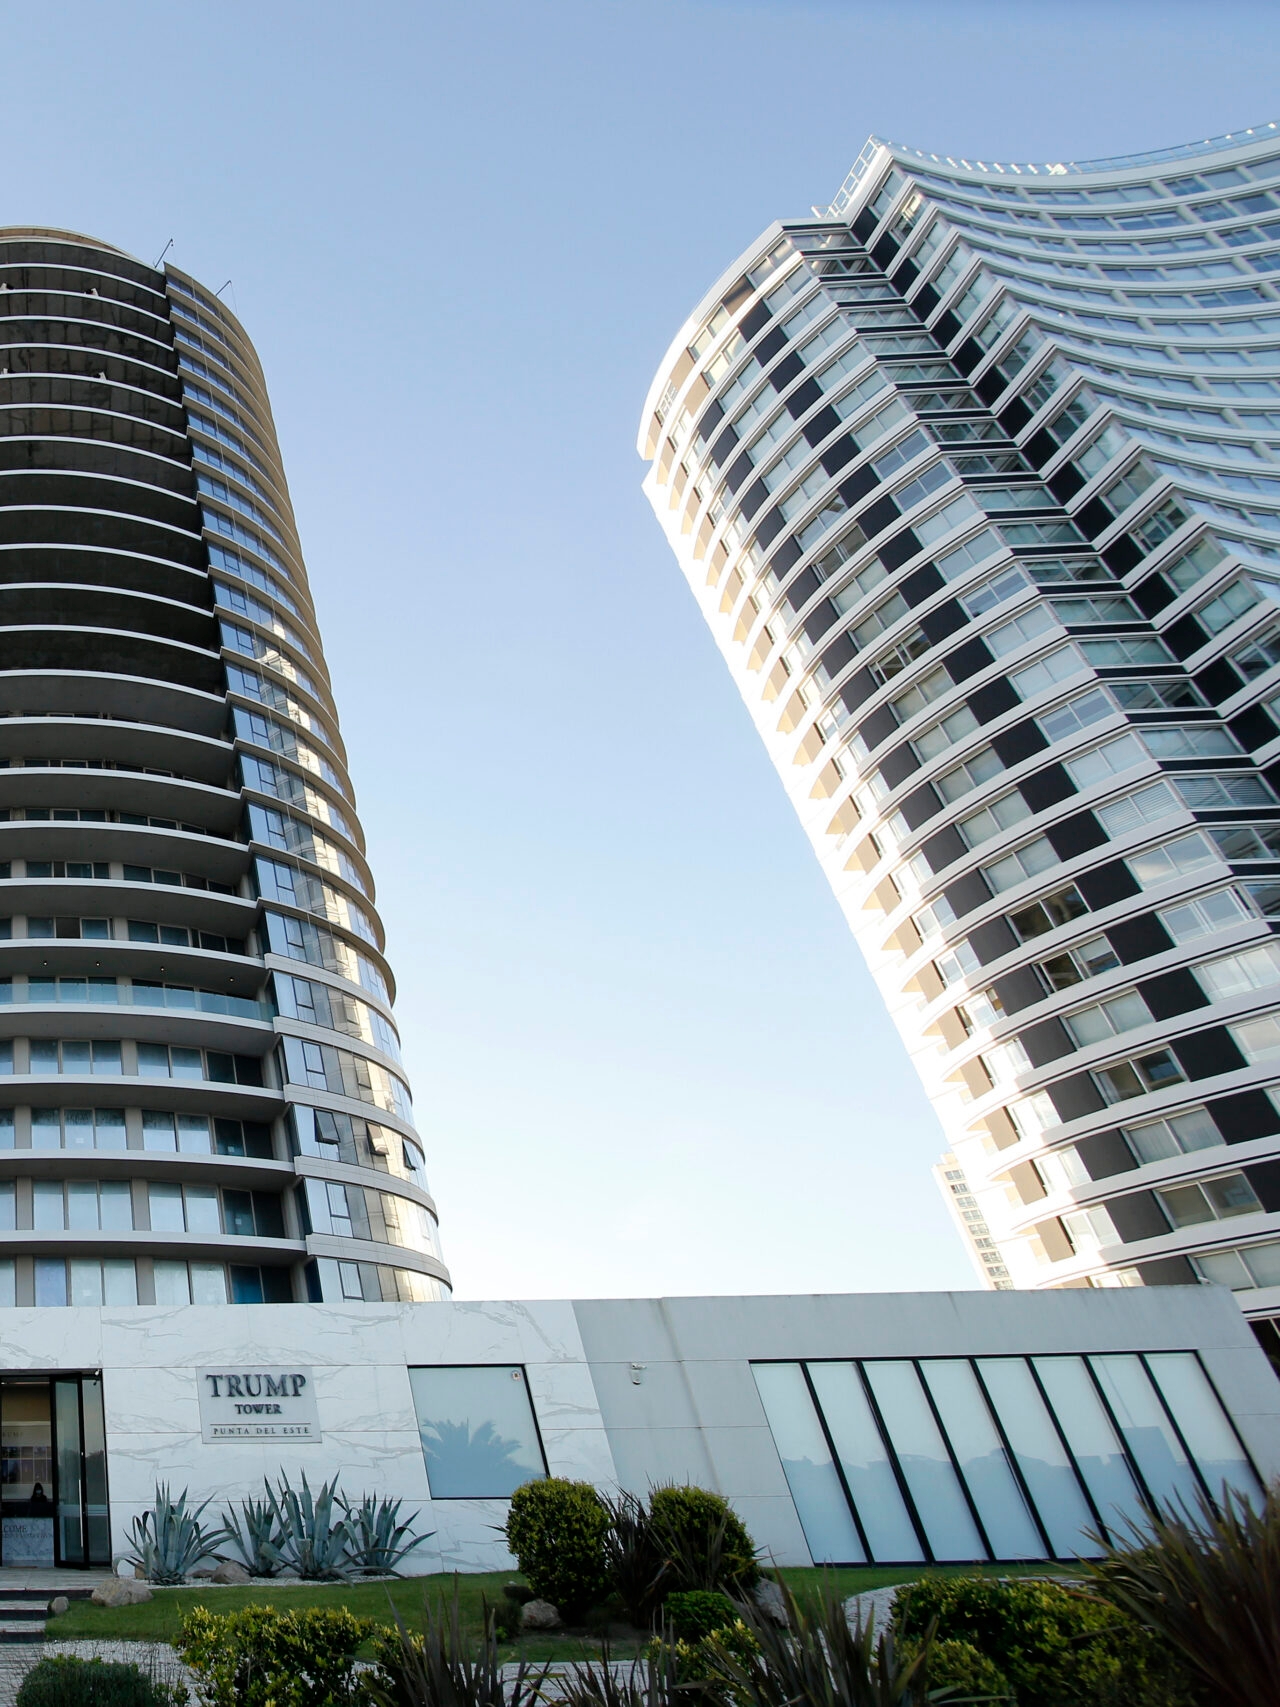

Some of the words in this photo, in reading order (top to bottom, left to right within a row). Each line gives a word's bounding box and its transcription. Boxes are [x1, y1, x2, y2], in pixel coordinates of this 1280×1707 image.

[205, 1374, 307, 1397] TRUMP
[234, 1403, 282, 1414] TOWER
[213, 1427, 250, 1435] PUNTA
[283, 1426, 309, 1434] ESTE
